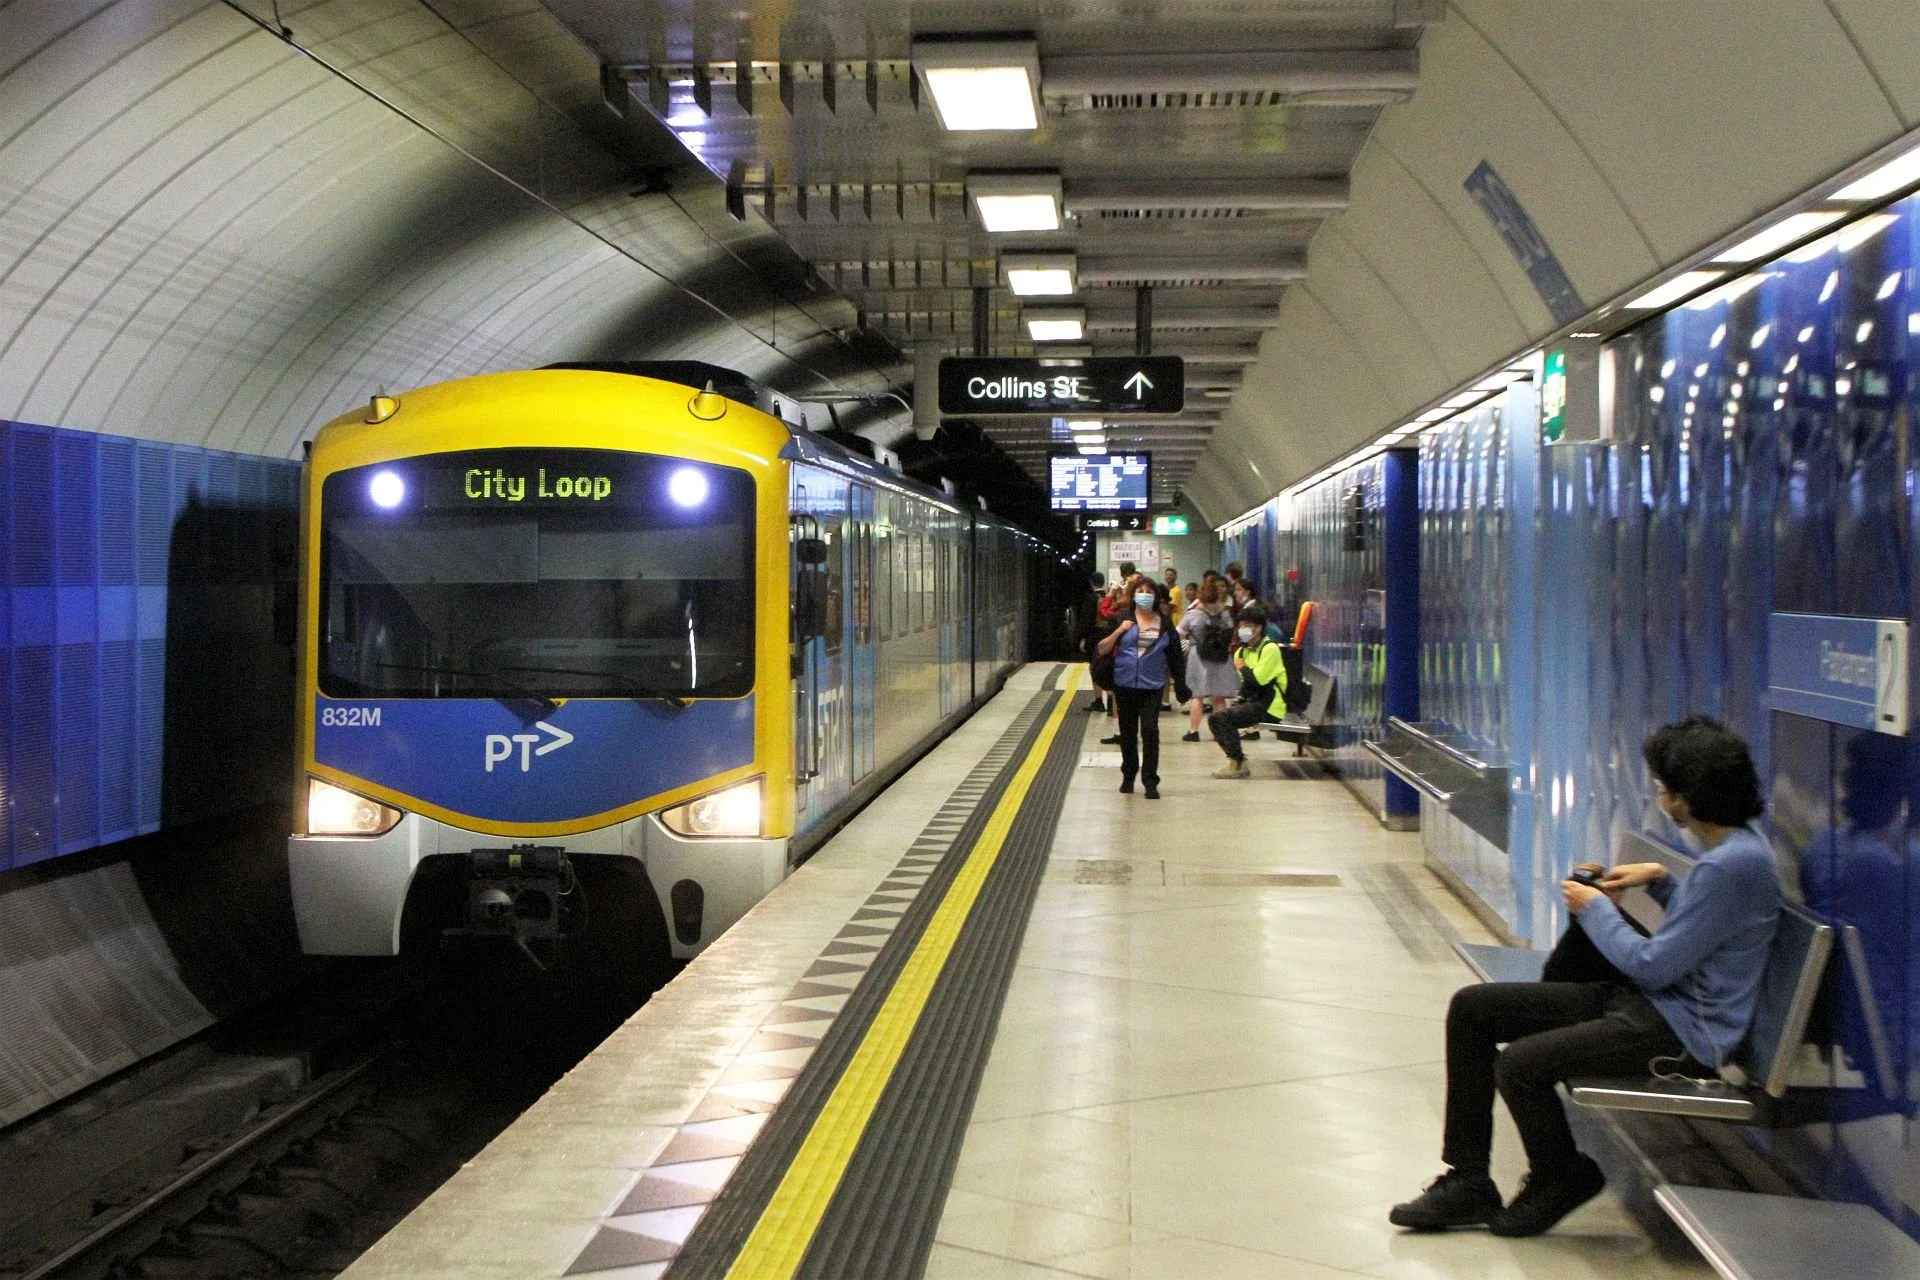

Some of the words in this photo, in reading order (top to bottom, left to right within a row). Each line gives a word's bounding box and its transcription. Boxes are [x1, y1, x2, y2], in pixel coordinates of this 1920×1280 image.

[968, 377, 1046, 398] Collins
[1054, 376, 1080, 398] St
[465, 469, 525, 501] City
[539, 469, 611, 500] Loop
[1086, 519, 1109, 527] Collins
[322, 707, 381, 726] 832M
